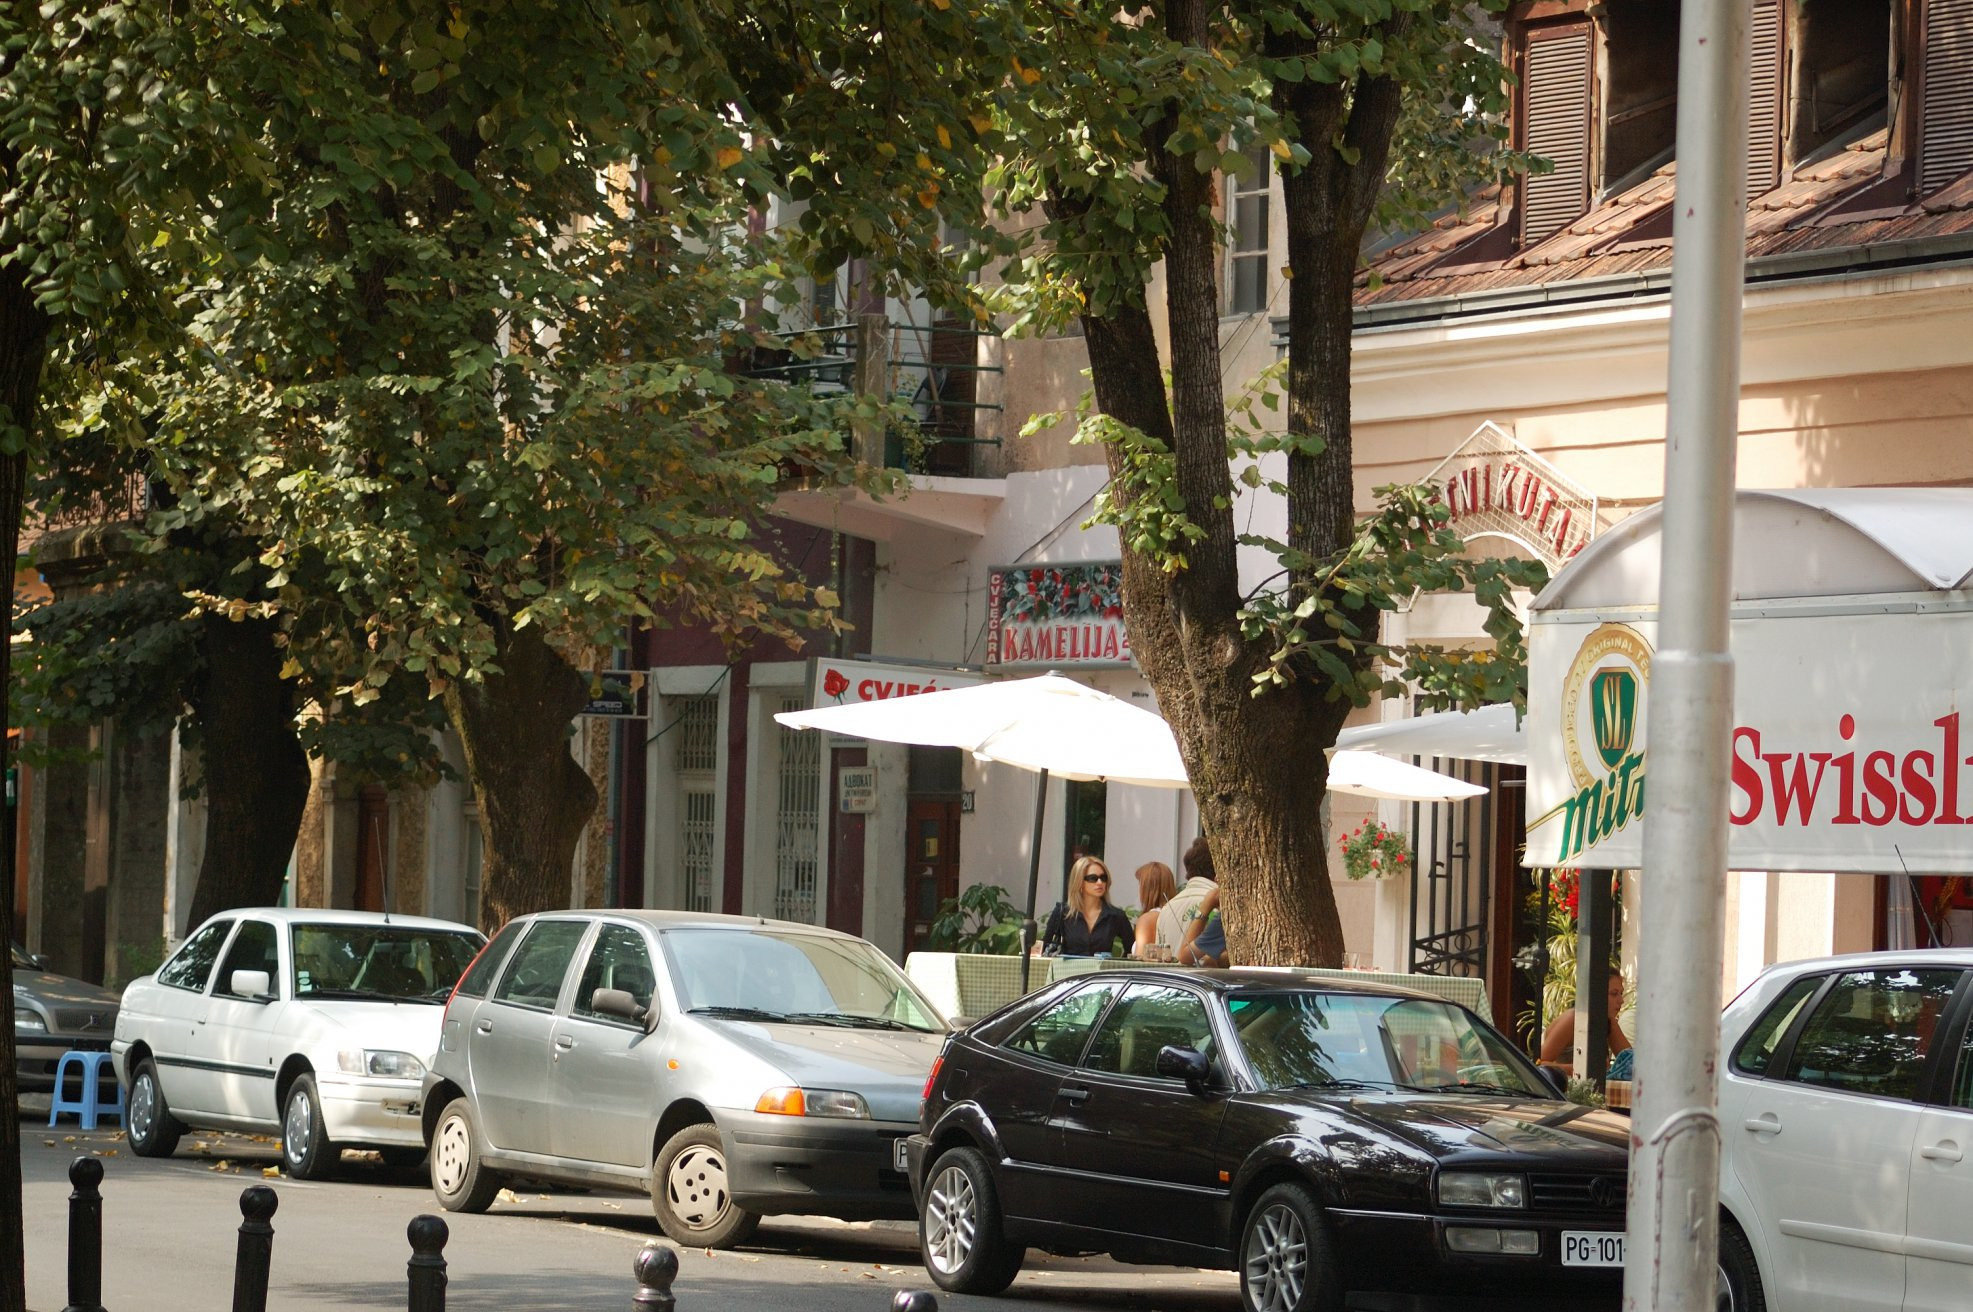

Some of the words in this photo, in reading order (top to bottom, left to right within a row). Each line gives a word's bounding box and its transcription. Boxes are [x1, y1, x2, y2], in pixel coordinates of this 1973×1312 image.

[1004, 624, 1119, 662] KAMELIJA
[1586, 636, 1634, 663] ORIGINAL
[858, 679, 951, 701] CVJE
[1601, 676, 1626, 750] SL
[1729, 712, 1973, 827] Swissl
[962, 793, 973, 810] 20
